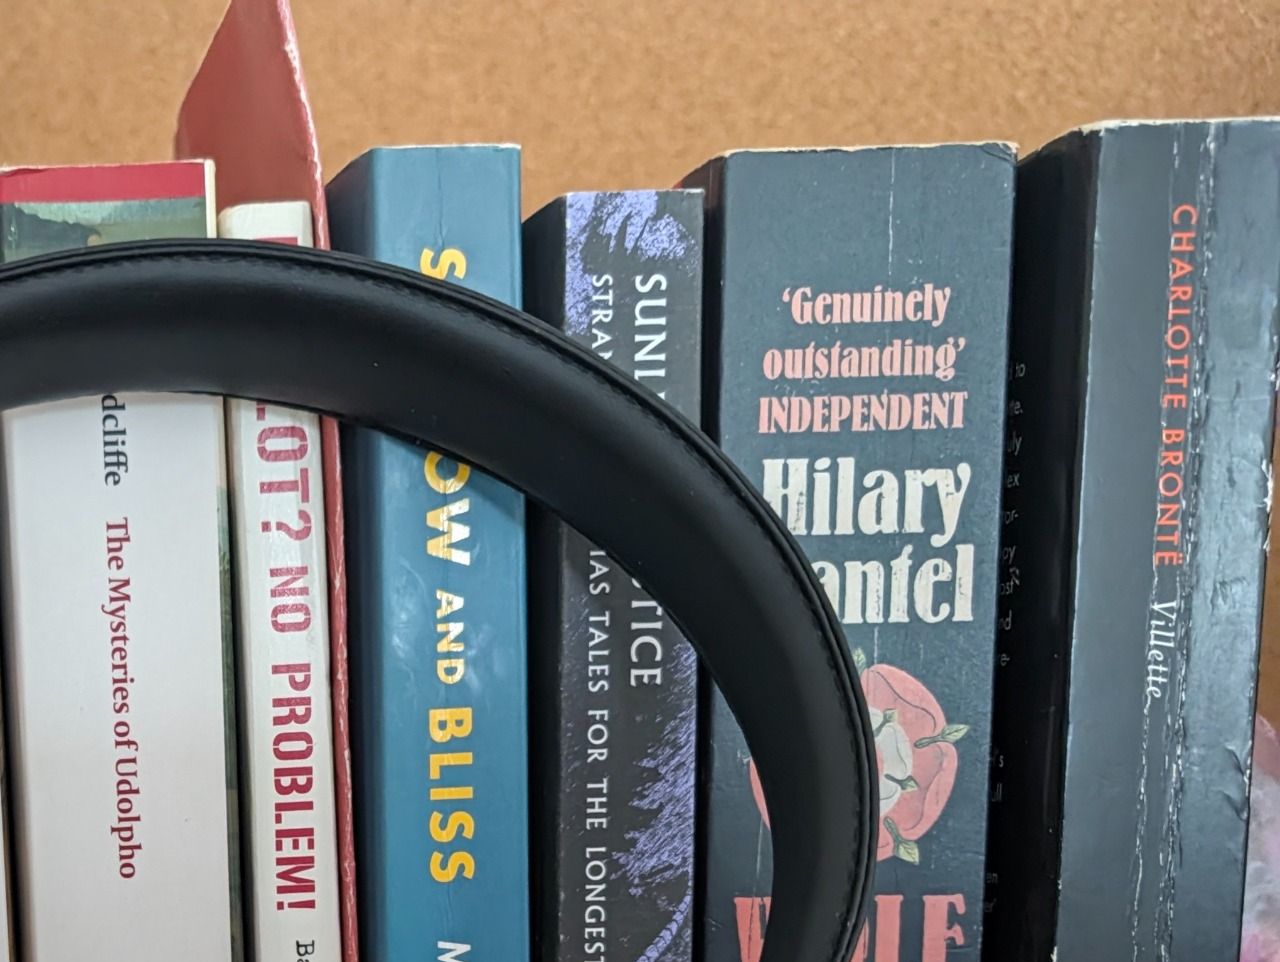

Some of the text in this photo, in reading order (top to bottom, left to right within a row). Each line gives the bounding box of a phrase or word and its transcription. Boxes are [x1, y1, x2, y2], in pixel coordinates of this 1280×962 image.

[591, 274, 614, 360] STRA
[634, 273, 667, 400] SUNL
[1161, 204, 1198, 409] CHARLOTTE
[758, 391, 968, 434] INDEPENDENT
[105, 517, 132, 571] The
[762, 456, 972, 547] Hilary
[101, 576, 135, 715] Mysteries
[269, 565, 312, 633] NO
[435, 588, 466, 686] AND
[630, 577, 663, 688] TICE
[587, 611, 610, 693] TALES
[1146, 599, 1178, 699] Villette
[113, 721, 139, 752] of
[586, 709, 609, 764] FOR
[110, 756, 143, 880] Udolpho
[271, 662, 317, 911] PROBLEM!
[428, 707, 476, 883] BLISS
[585, 778, 608, 831] THE
